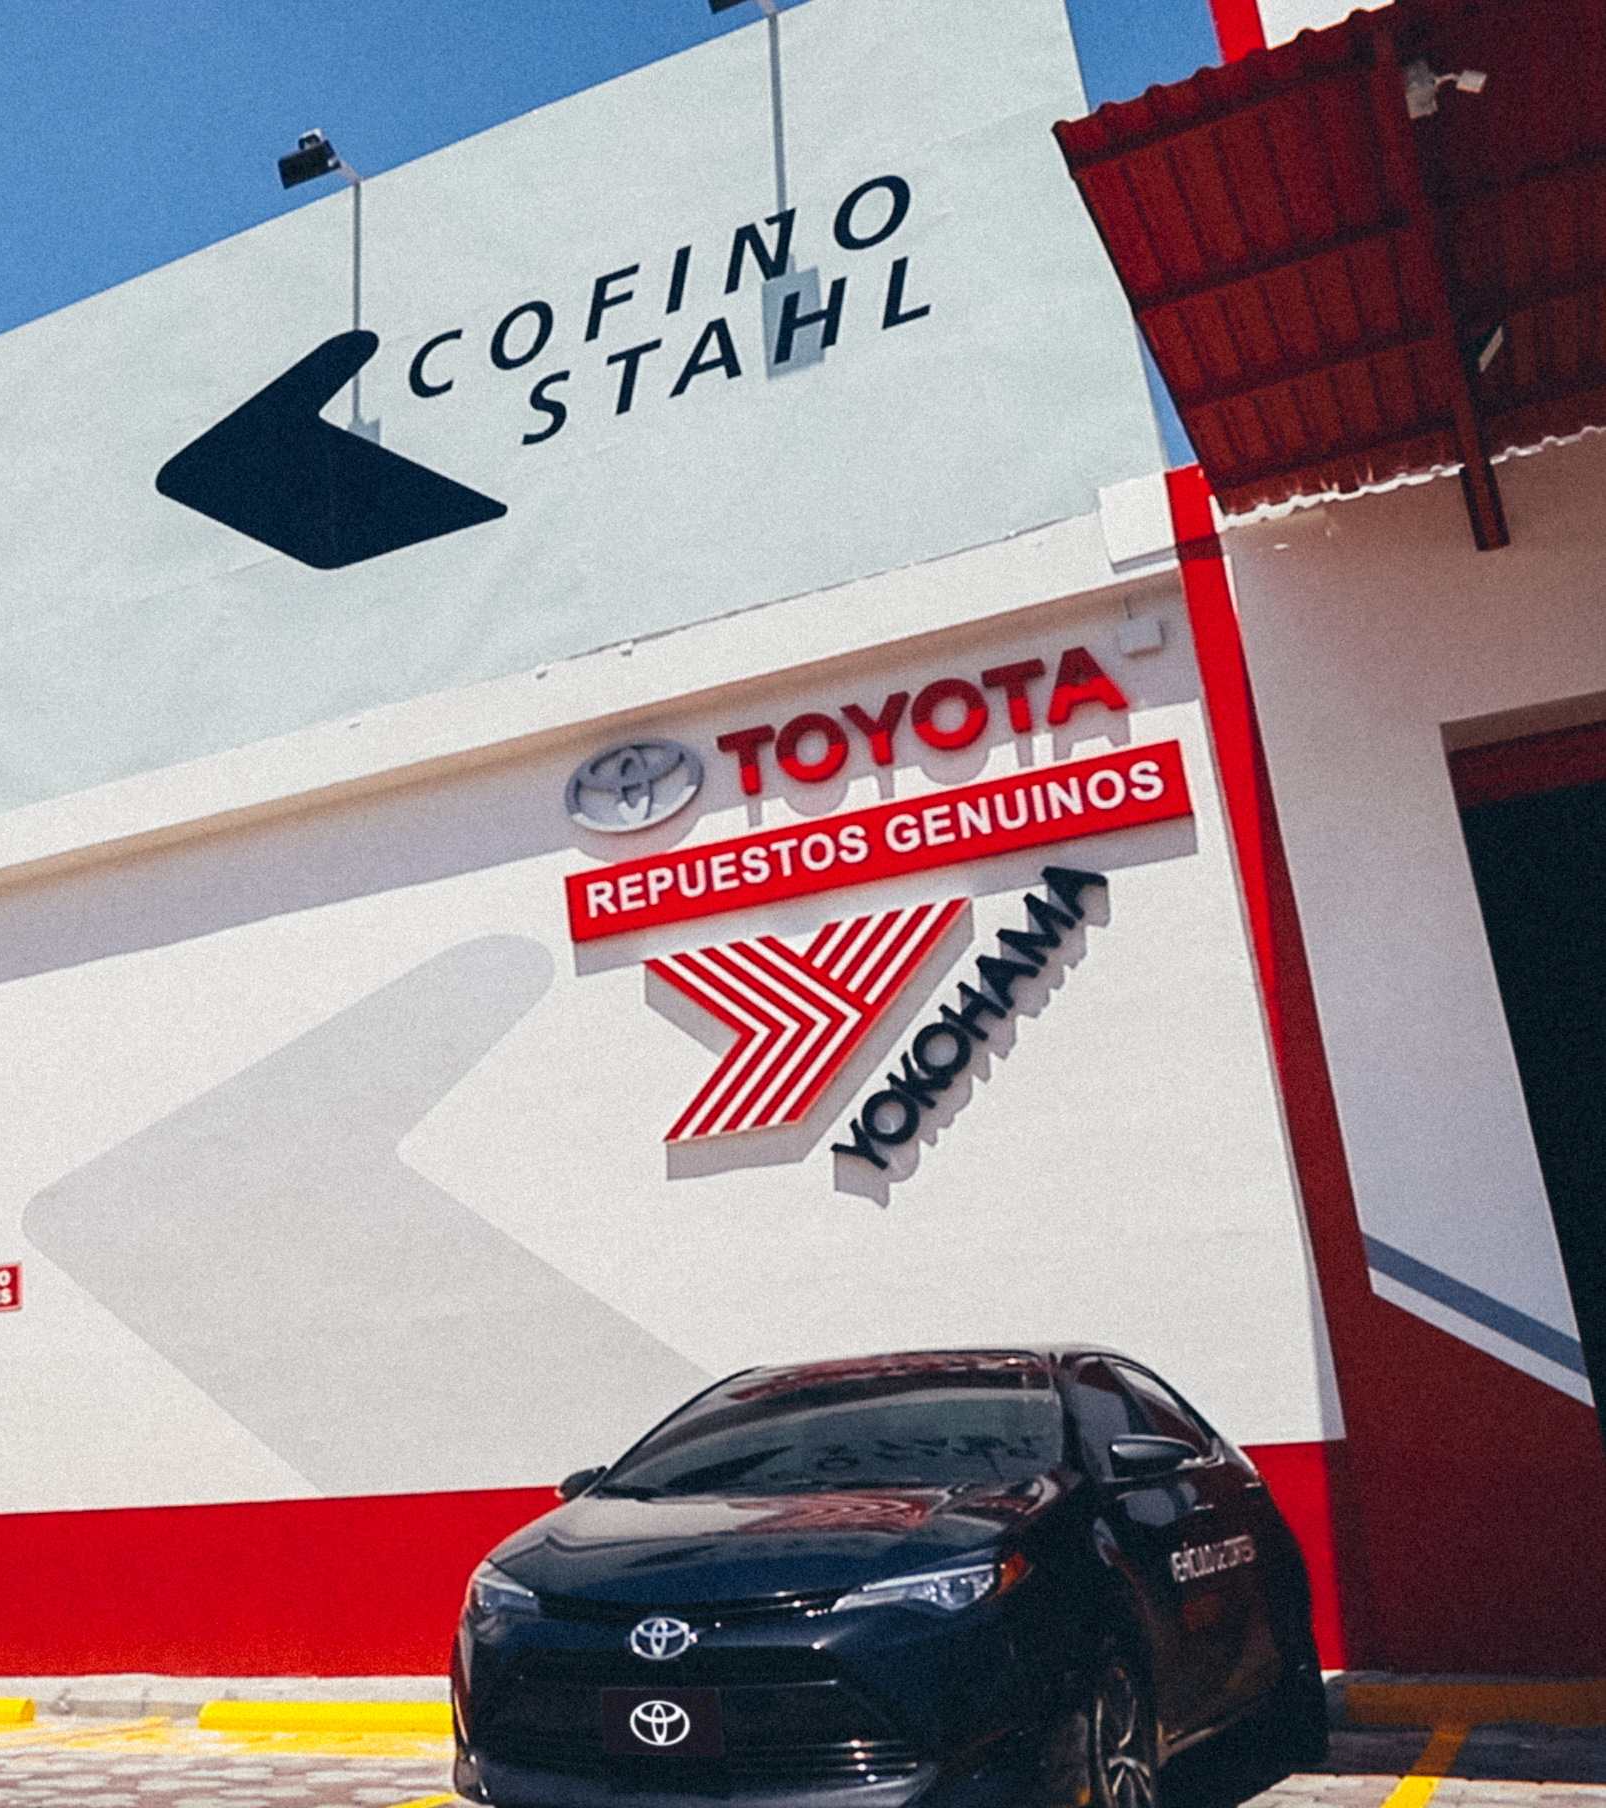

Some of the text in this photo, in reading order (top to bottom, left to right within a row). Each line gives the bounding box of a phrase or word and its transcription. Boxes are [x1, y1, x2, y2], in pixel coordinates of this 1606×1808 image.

[408, 175, 911, 398] COFINO
[522, 257, 931, 445] STAHL
[717, 646, 1128, 796] TOYOTA
[586, 760, 1165, 917] REPUESTOS GENUINOS
[830, 866, 1108, 1170] YOKOHAMA
